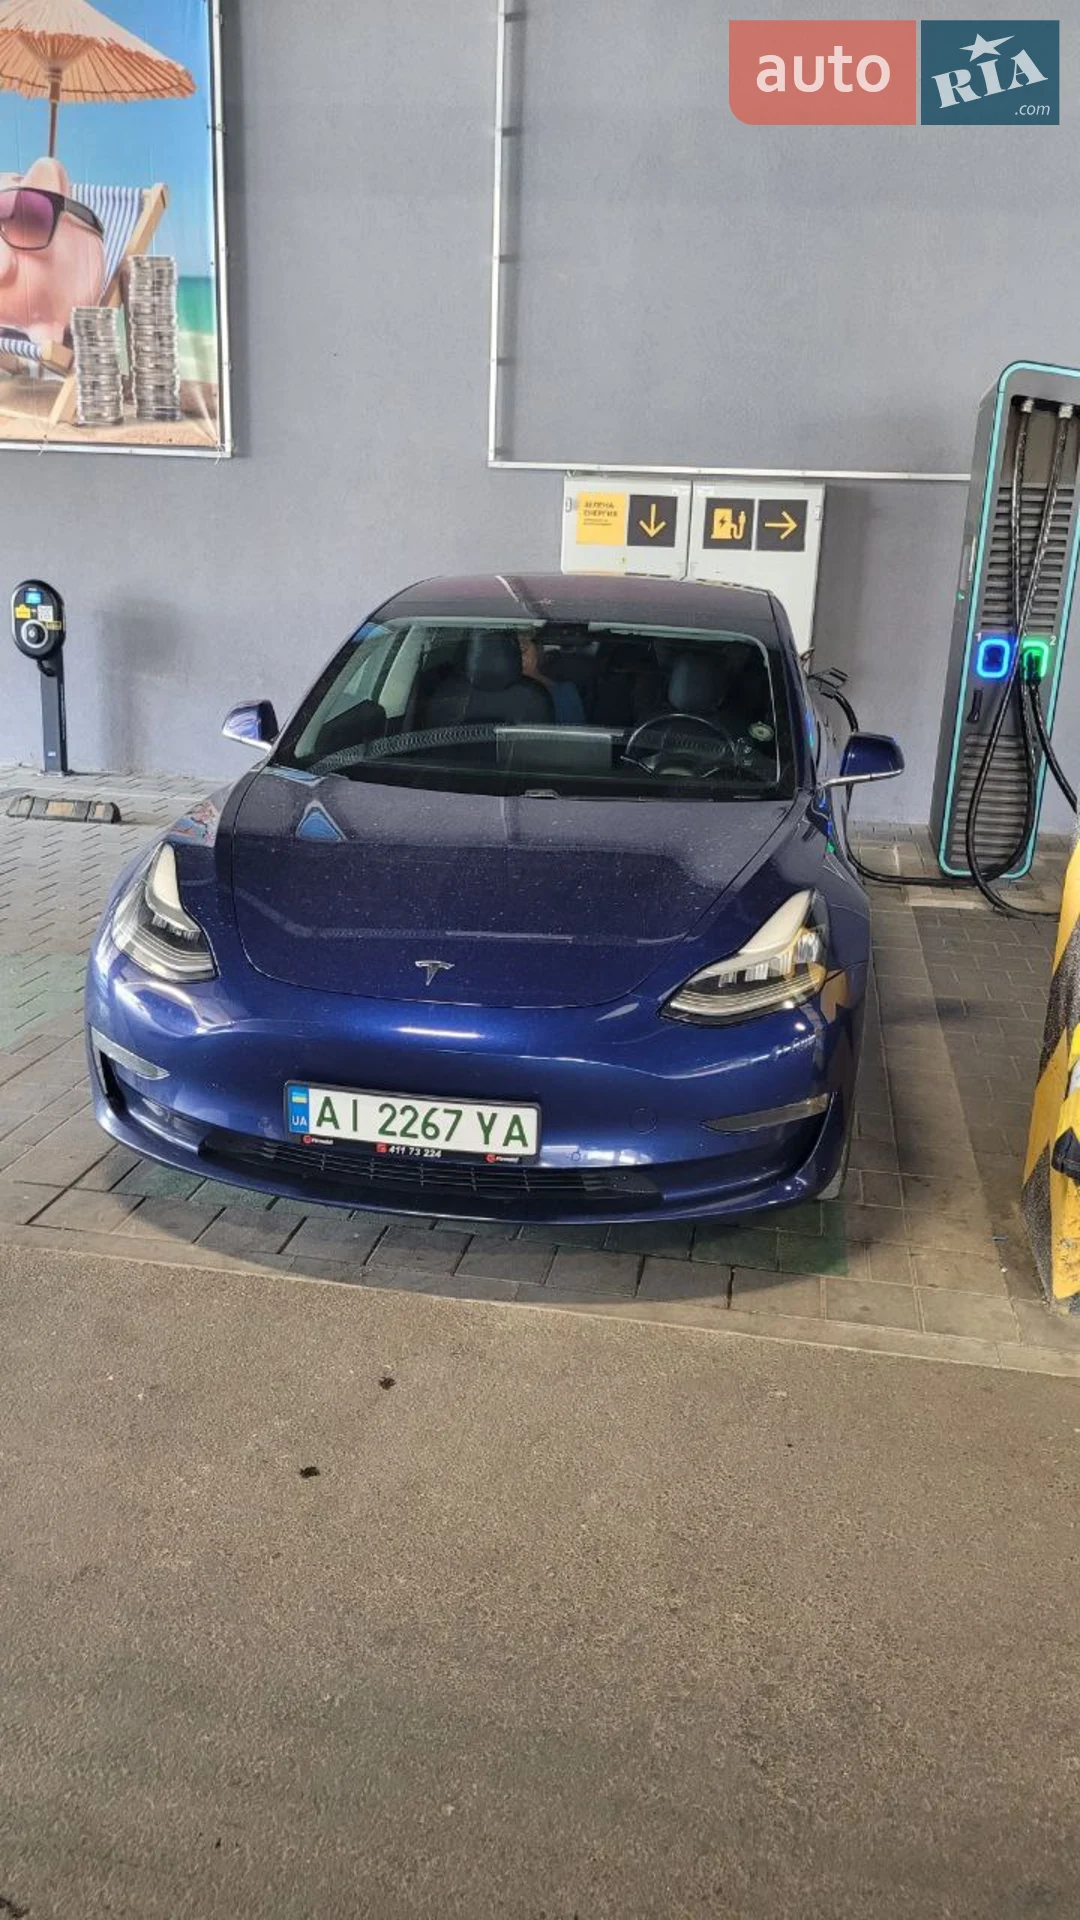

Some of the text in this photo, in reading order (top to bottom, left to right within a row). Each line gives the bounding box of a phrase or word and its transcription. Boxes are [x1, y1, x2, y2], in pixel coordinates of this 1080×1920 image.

[975, 632, 982, 642] 1
[1049, 635, 1057, 646] 2
[291, 1115, 307, 1127] UA
[316, 1096, 529, 1147] AI 2267 YA
[409, 1147, 421, 1156] 73
[423, 1148, 442, 1158] 224
